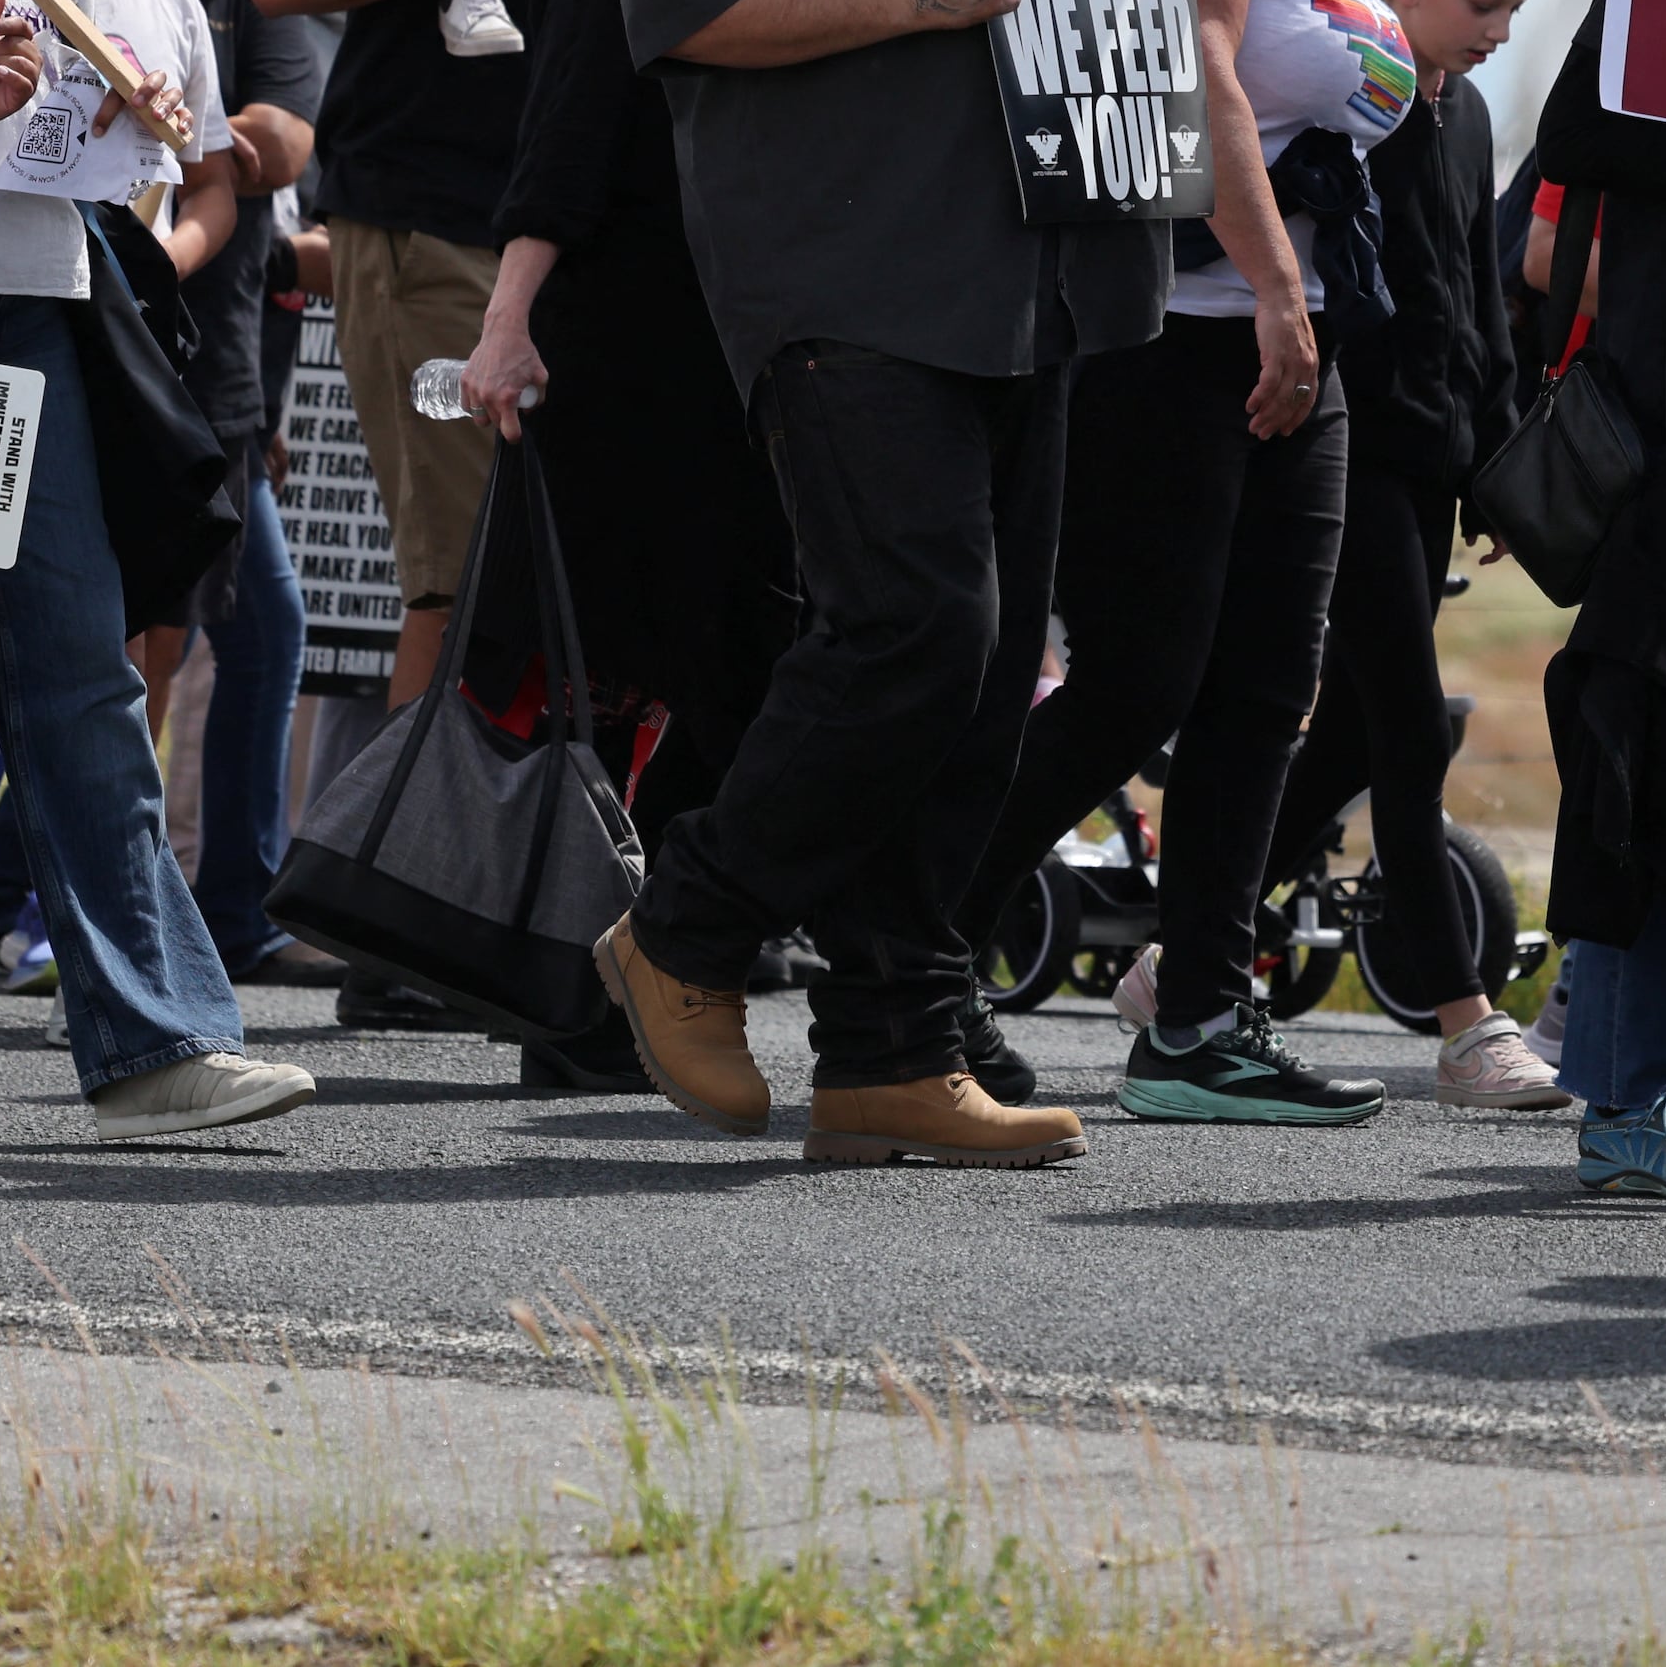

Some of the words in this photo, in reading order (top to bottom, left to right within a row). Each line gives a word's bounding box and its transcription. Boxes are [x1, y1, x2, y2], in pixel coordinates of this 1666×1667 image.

[1064, 94, 1173, 201] YOU!
[294, 382, 323, 407] WE
[5, 416, 26, 467] STAND
[289, 415, 318, 441] WE
[310, 486, 367, 514] DRIVE
[305, 520, 349, 548] HEAL
[357, 524, 391, 551] YOU
[301, 554, 355, 582] MAKE
[337, 592, 402, 620] UNITED
[336, 647, 381, 677] FARM
